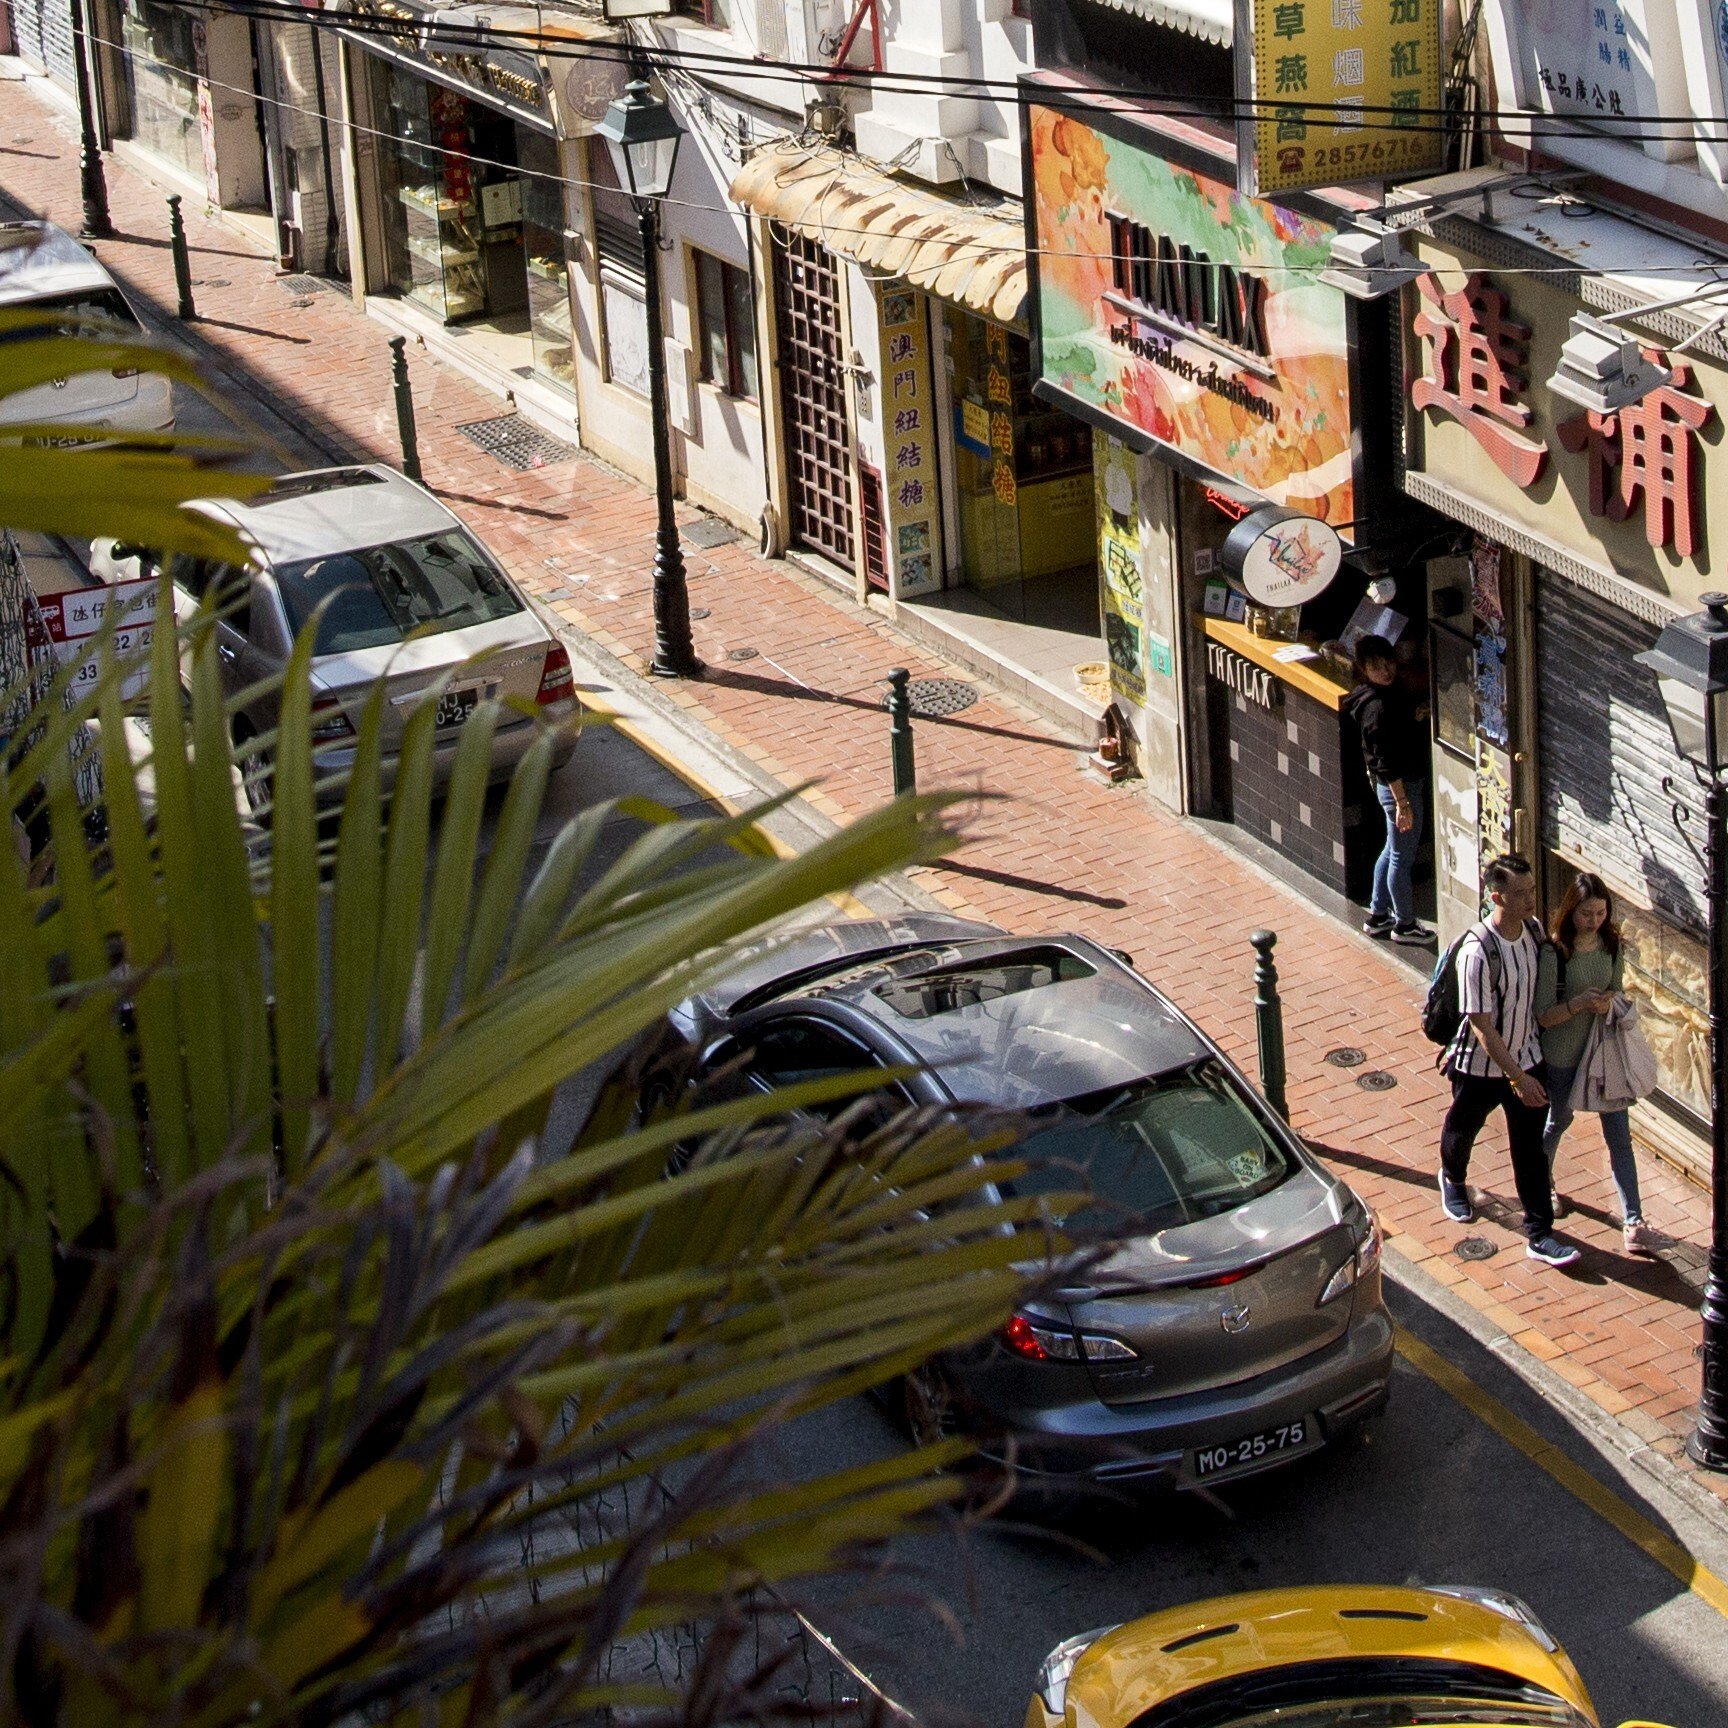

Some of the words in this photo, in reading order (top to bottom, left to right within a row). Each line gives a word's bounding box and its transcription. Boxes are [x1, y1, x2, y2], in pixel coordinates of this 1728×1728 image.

[1314, 137, 1424, 169] 28576716
[1104, 207, 1271, 359] THAILAX
[889, 332, 925, 509] 澳門紐結糖
[78, 663, 98, 681] 33
[1207, 642, 1272, 710] THAILAX
[1198, 1420, 1305, 1474] MO-25-75
